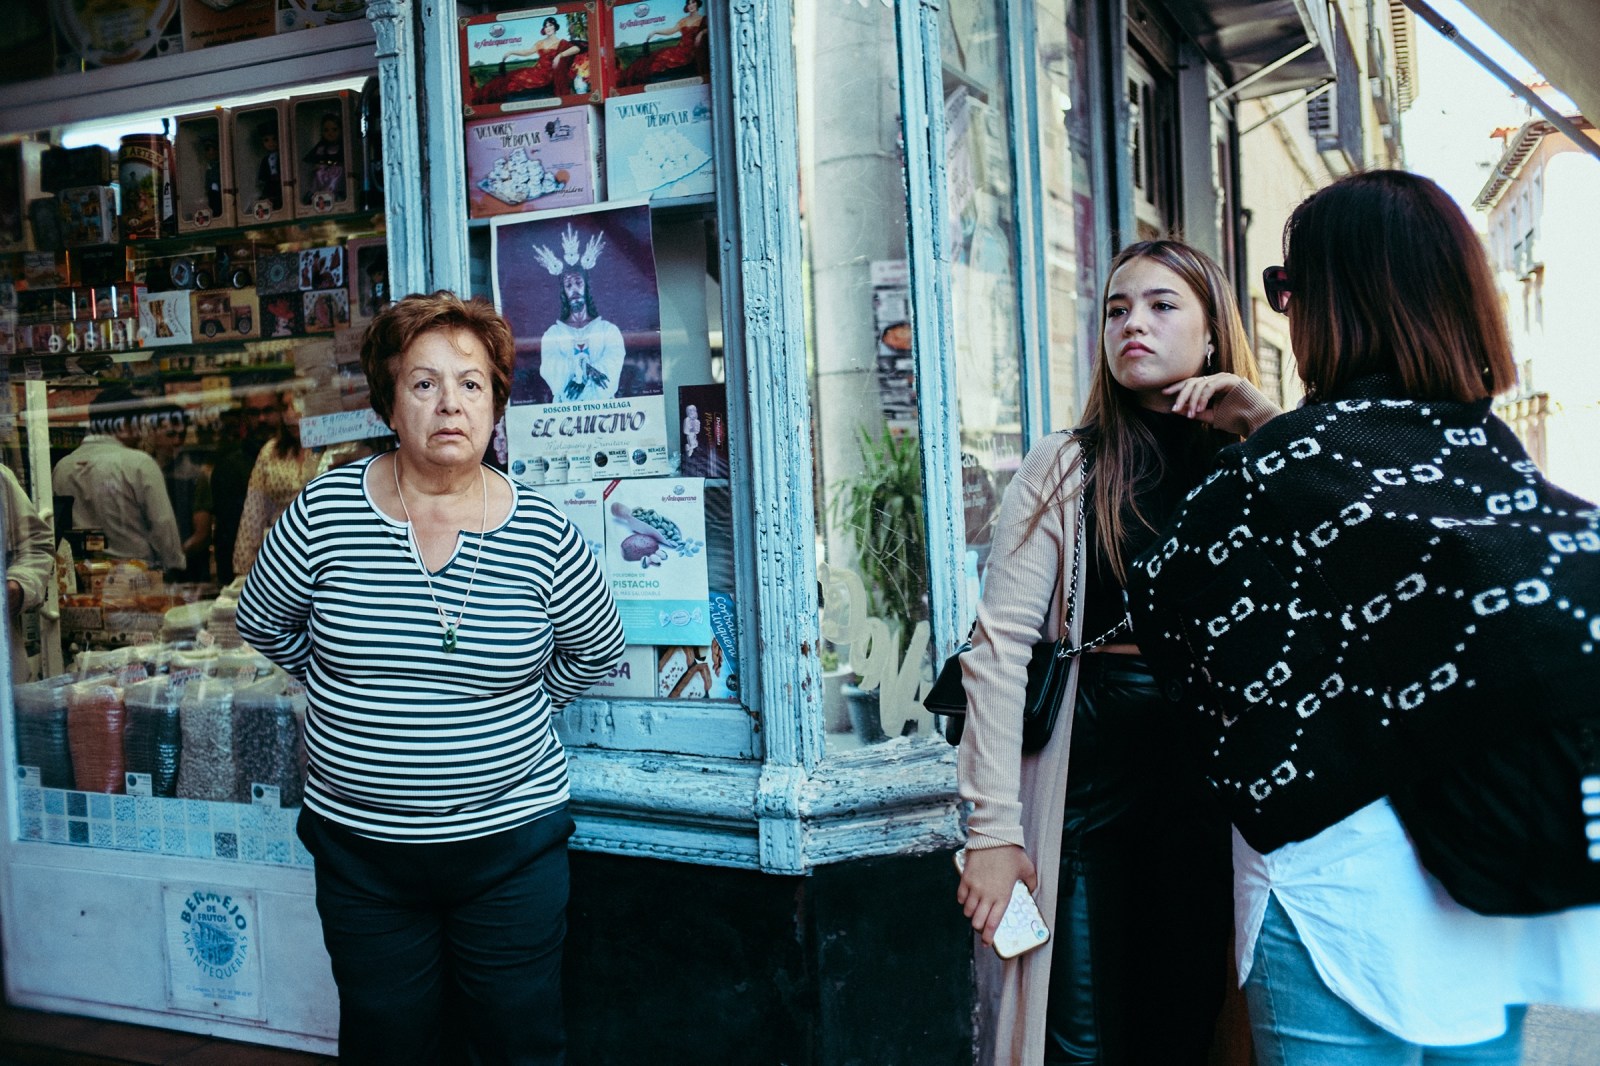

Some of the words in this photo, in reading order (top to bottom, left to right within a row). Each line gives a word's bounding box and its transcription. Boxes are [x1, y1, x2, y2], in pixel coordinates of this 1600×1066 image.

[543, 405, 571, 414] ROSCOS
[583, 403, 601, 411] VINO
[531, 417, 557, 438] EL
[559, 411, 647, 437] CAUTIVO
[180, 890, 248, 931] BERMEJO
[207, 905, 217, 914] DE
[199, 914, 228, 923] FRUTOS
